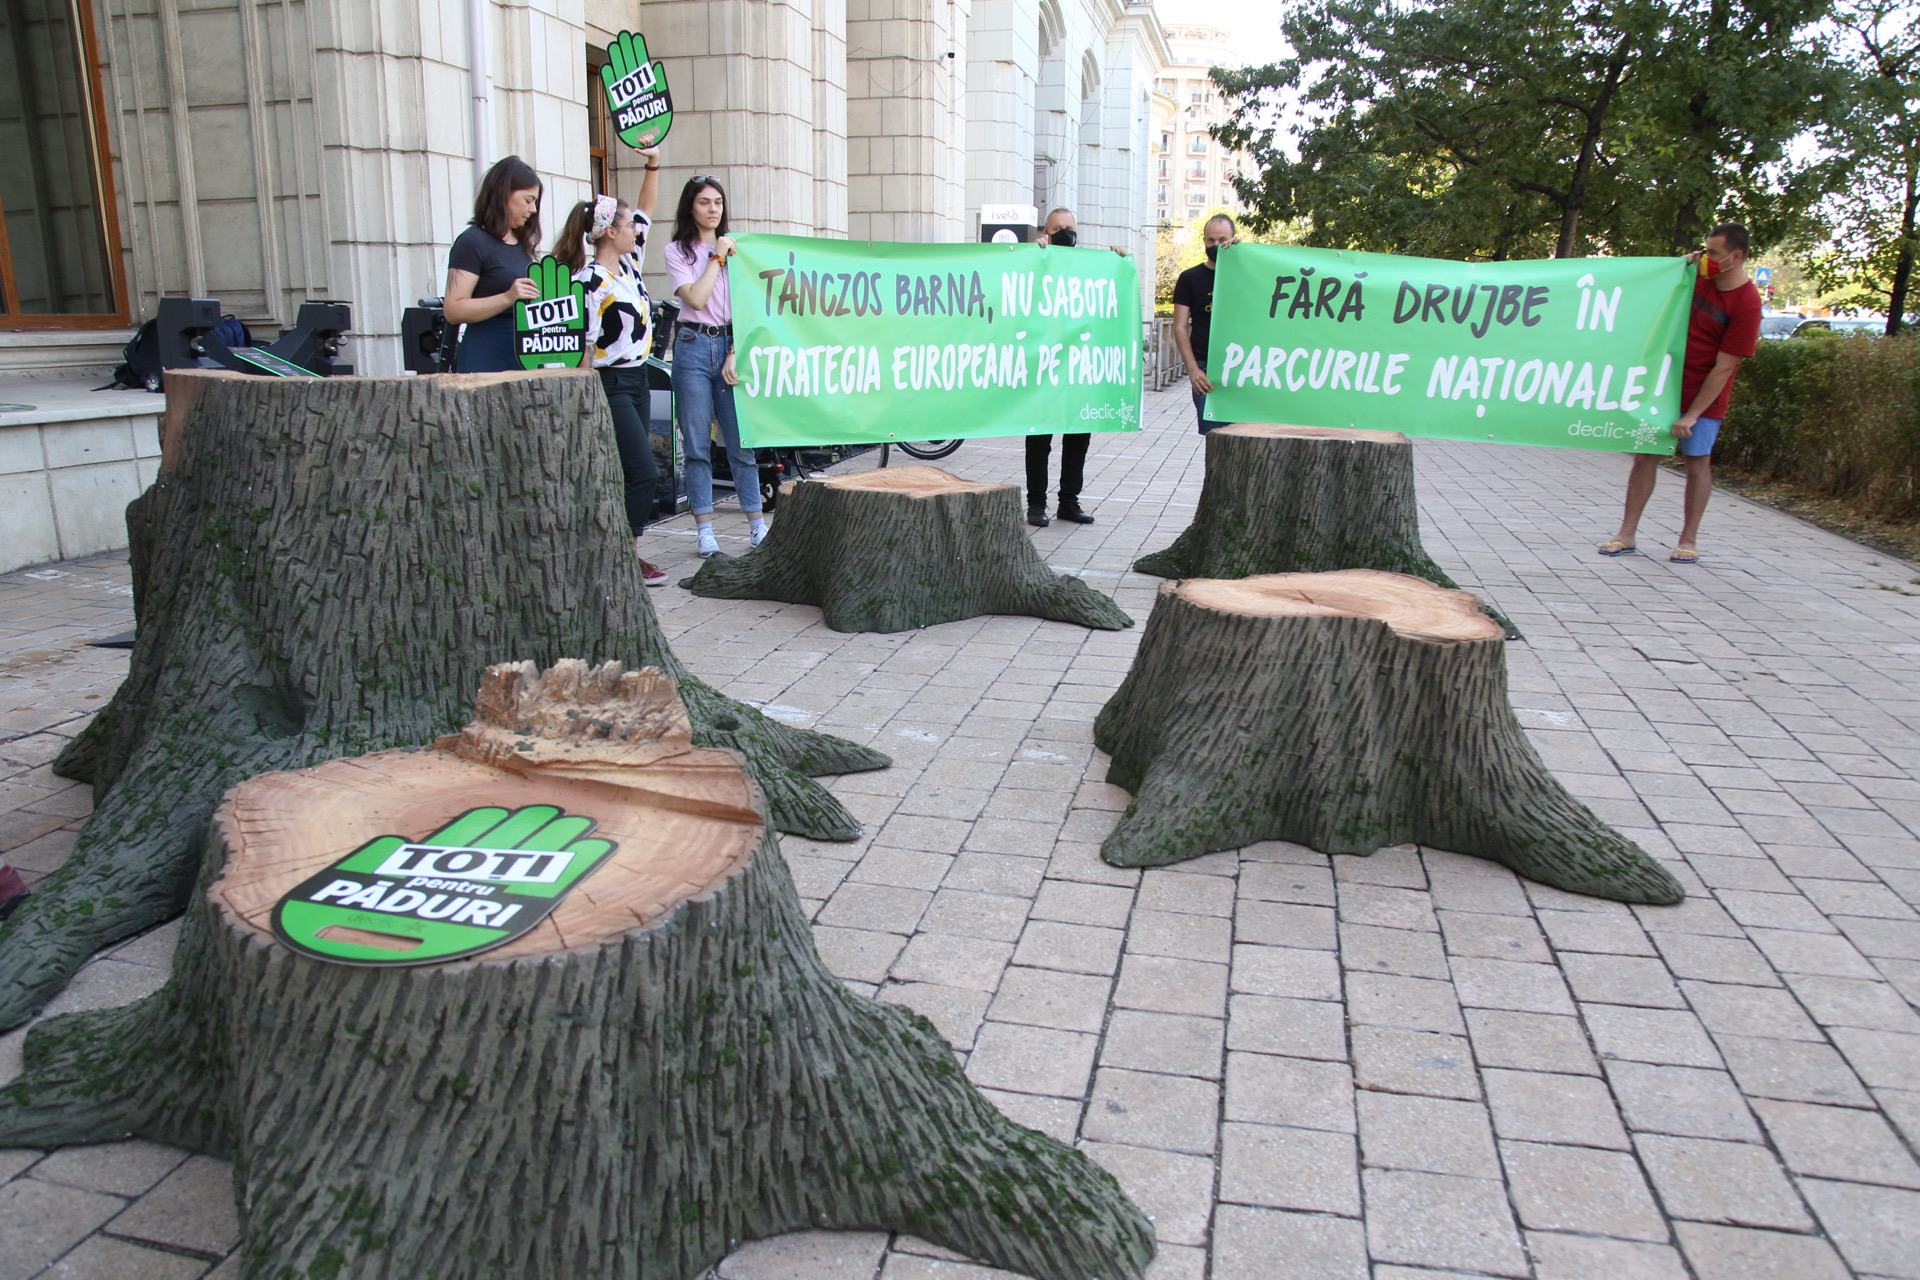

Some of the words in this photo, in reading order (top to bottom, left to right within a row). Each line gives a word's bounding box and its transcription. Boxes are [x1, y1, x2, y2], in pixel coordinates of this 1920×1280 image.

[632, 92, 654, 107] pentru
[618, 97, 668, 130] PĂDURI
[758, 251, 882, 317] TÁNCZOS
[896, 270, 994, 324] BARNA,
[1001, 271, 1034, 317] NU
[1038, 274, 1118, 319] SABOTA
[1269, 267, 1368, 323] FĂRĂ
[1393, 280, 1550, 339] DRUJBE
[1576, 273, 1622, 333] ÎN
[522, 333, 580, 353] PĂDURI
[541, 325, 567, 336] pentru
[744, 344, 881, 398] STRATEGIA
[1036, 343, 1064, 387] PE
[1221, 342, 1410, 395] PARCURILE
[1080, 403, 1116, 420] declic
[1567, 419, 1625, 439] declic
[404, 875, 497, 897] pentru
[309, 879, 524, 927] PĂDURI
